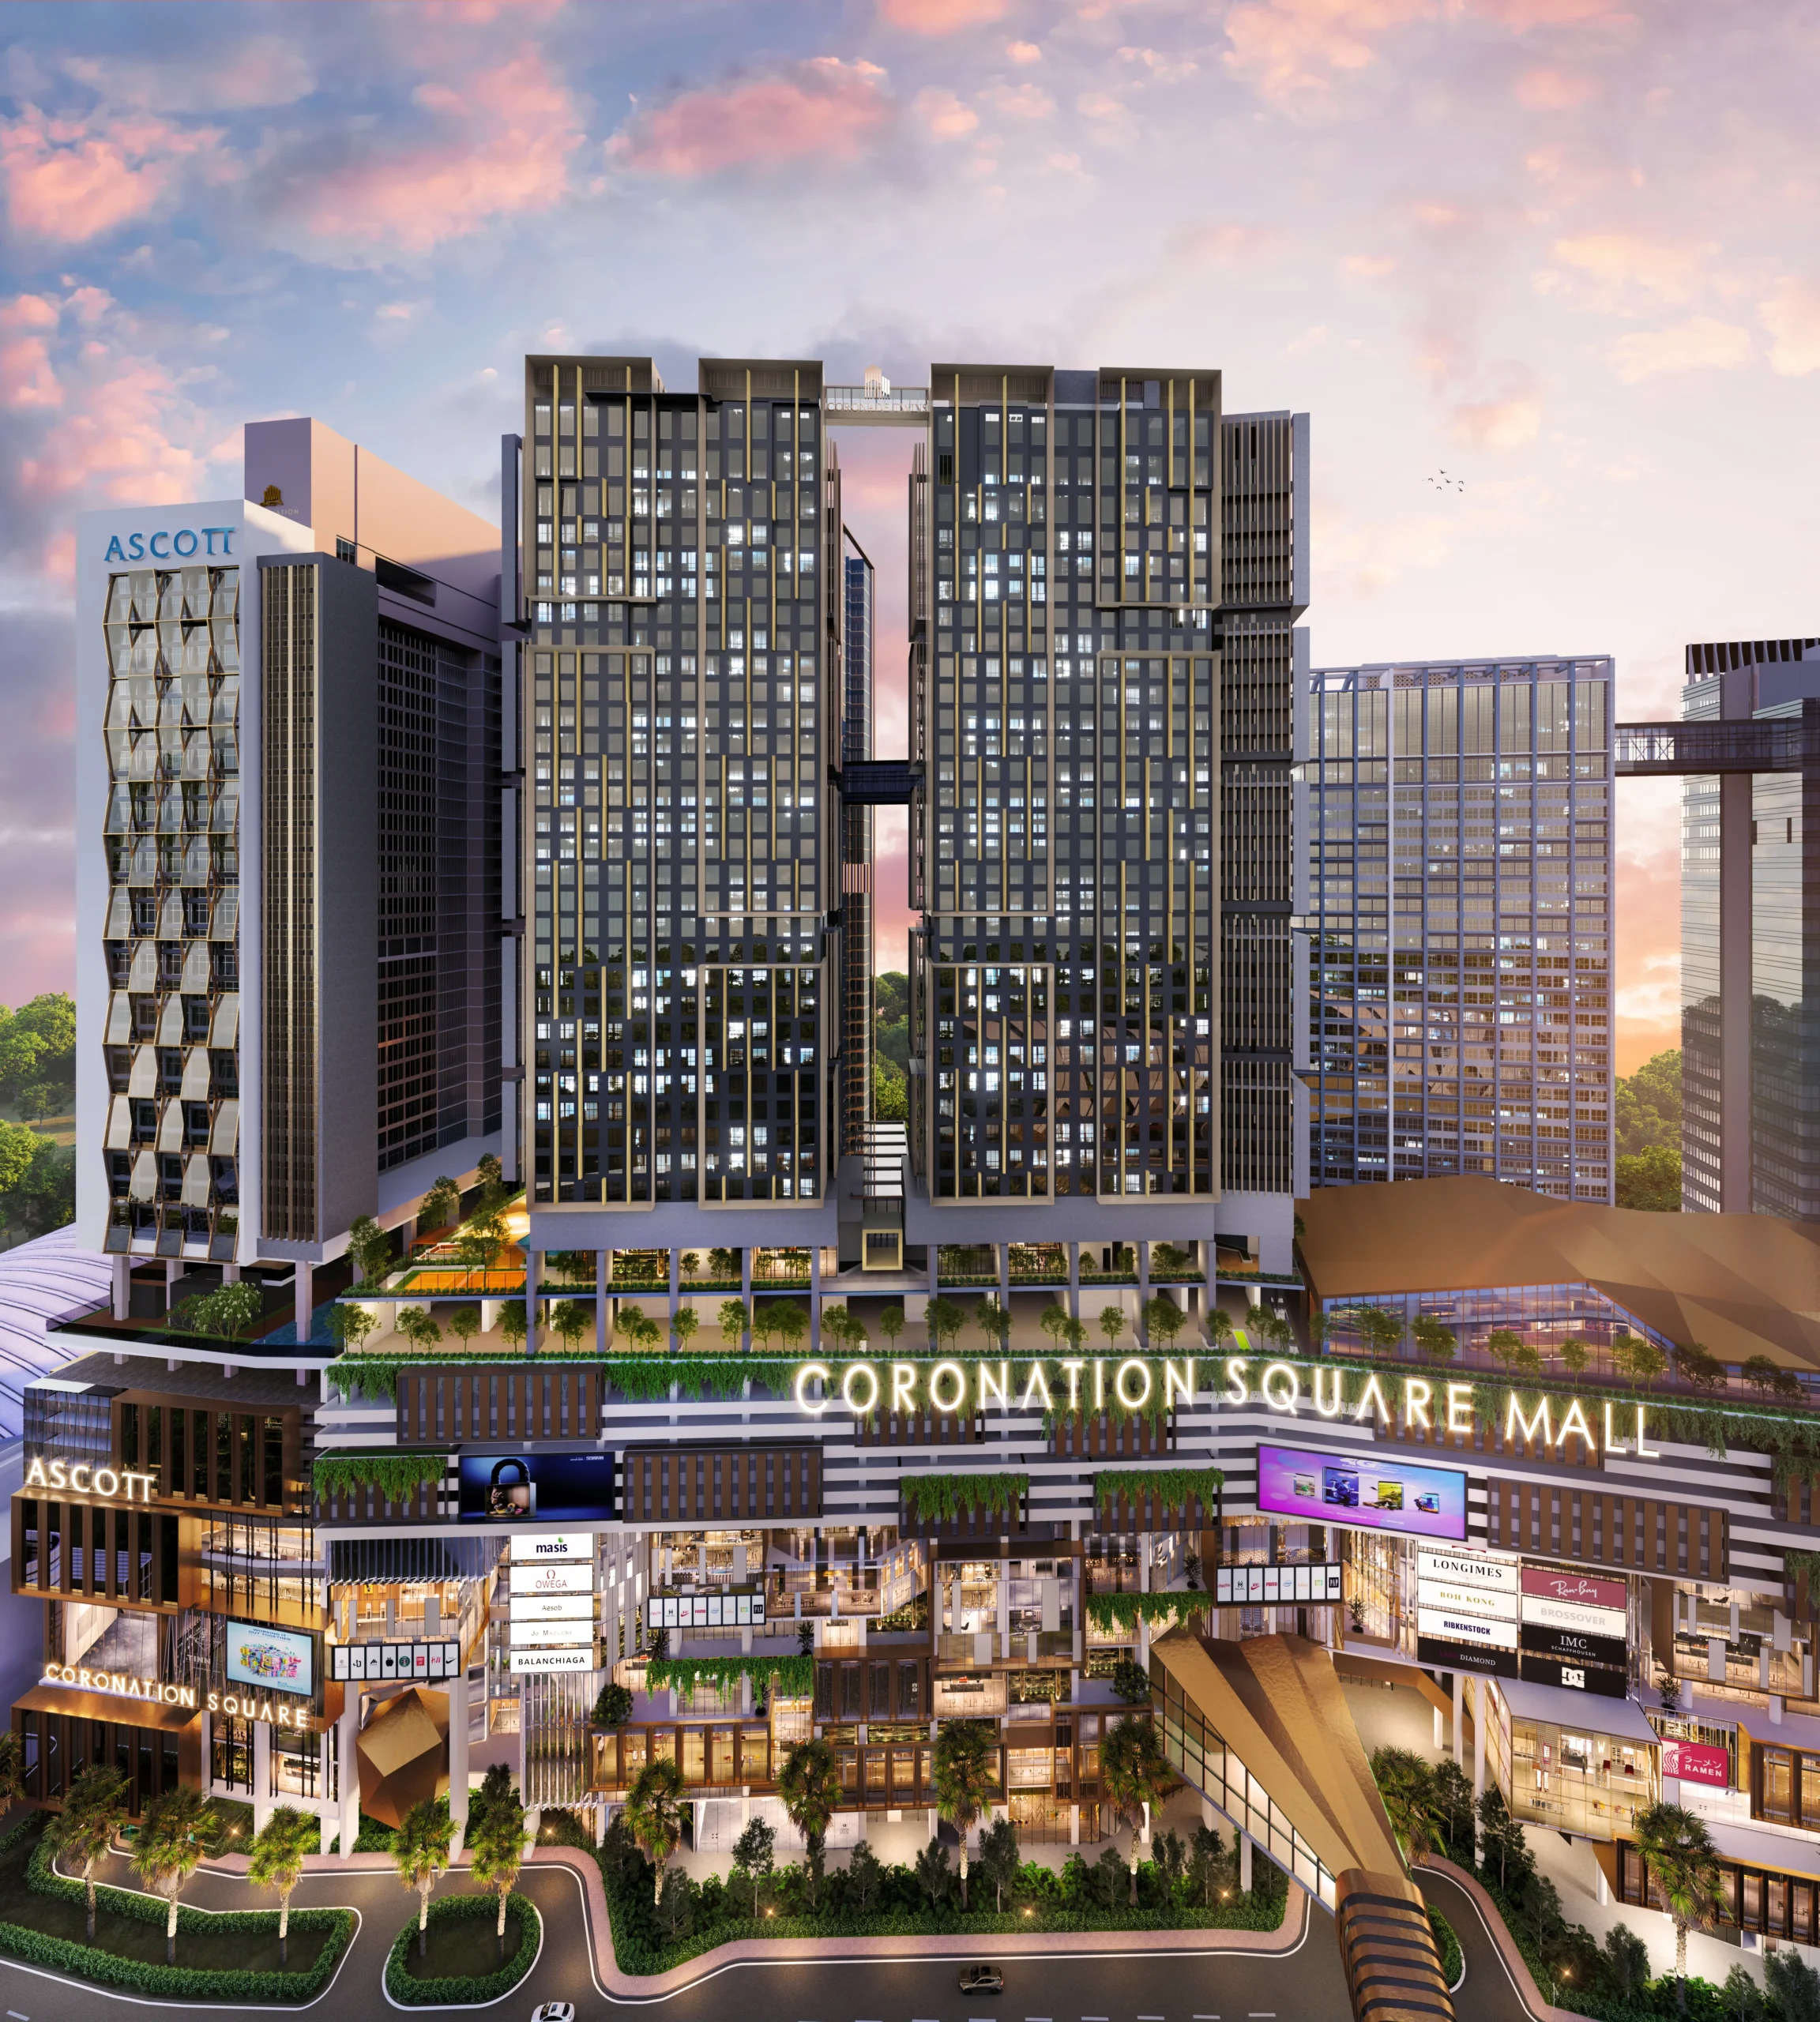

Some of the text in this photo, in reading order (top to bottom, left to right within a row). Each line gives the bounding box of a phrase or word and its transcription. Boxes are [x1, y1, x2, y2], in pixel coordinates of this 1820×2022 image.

[104, 527, 235, 561] ASCOTT
[795, 1359, 1660, 1457] CORONATION SQUARE MALL
[26, 1458, 155, 1502] ASCOTT
[536, 1537, 568, 1553] masis
[1433, 1558, 1502, 1578] LONGIMES
[536, 1580, 567, 1588] OWEGA
[1440, 1592, 1495, 1607] BOH KONG
[1540, 1607, 1606, 1625] BROSSOVER
[1444, 1621, 1491, 1635] RIBKENSTOCK
[1560, 1635, 1586, 1648] IMC
[1460, 1654, 1495, 1666] DIAMOND
[46, 1663, 309, 1727] CORONATION SQUARE
[1684, 1755, 1721, 1768] ラーメン
[1684, 1764, 1722, 1777] RAMEN
